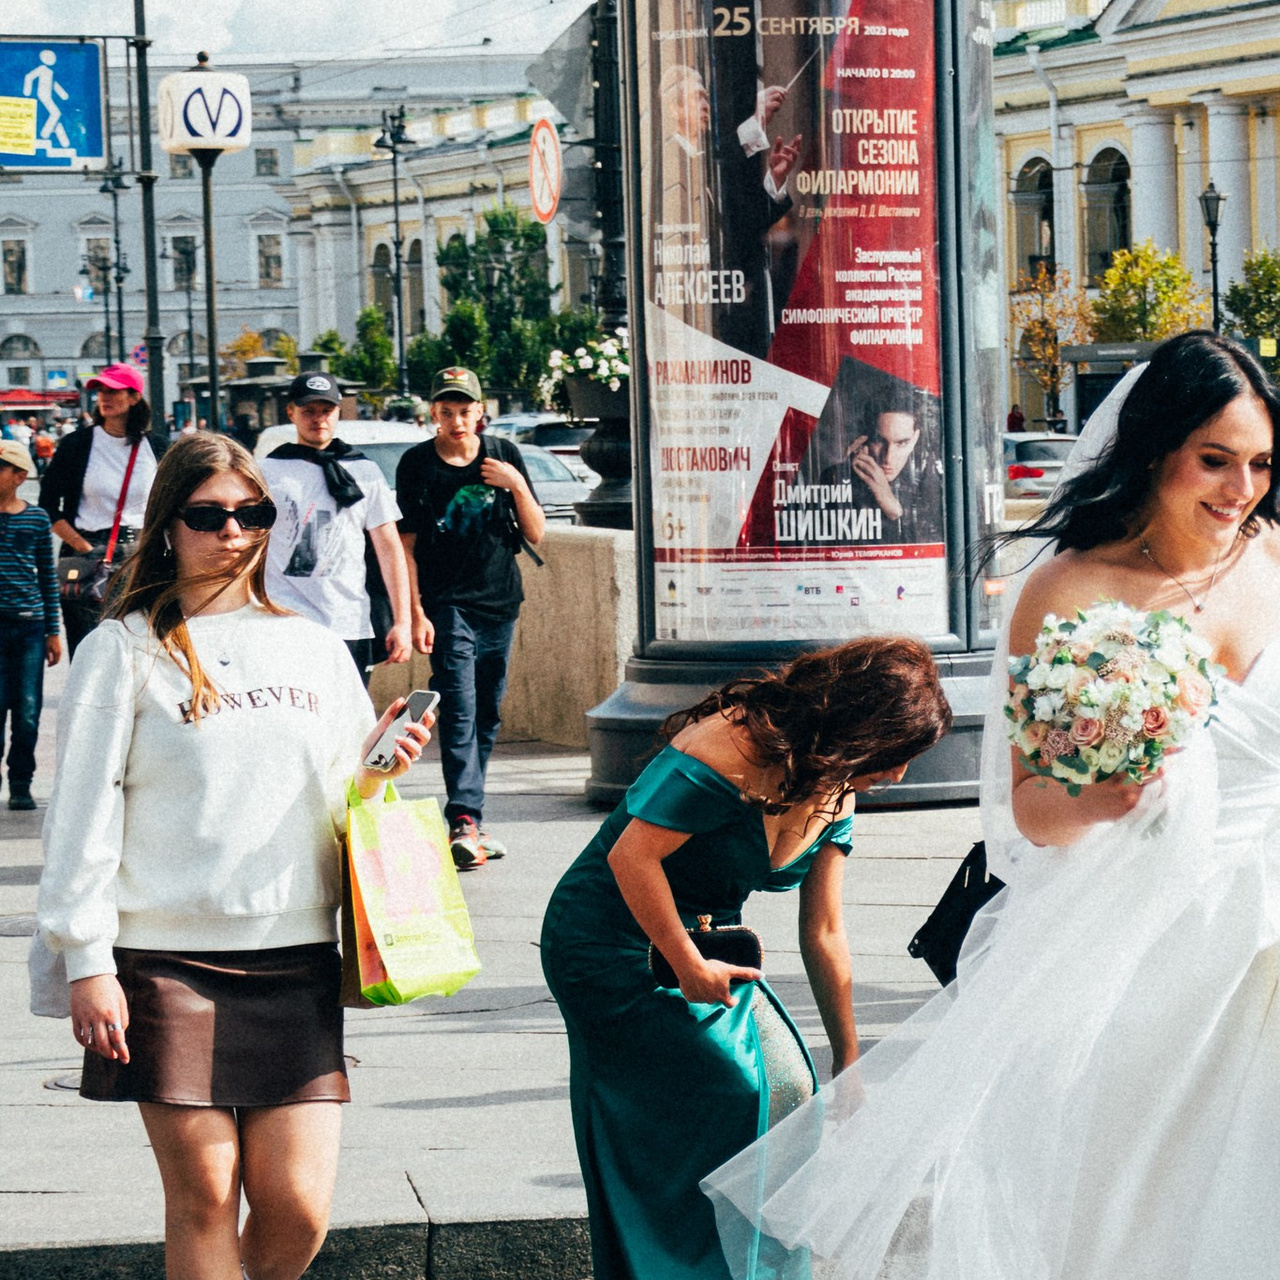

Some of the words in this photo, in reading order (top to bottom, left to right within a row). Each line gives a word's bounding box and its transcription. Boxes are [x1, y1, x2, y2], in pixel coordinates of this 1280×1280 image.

[713, 6, 751, 37] 25
[755, 17, 859, 36] СЕНТЯБРЯ
[864, 25, 887, 36] 2023
[888, 26, 909, 37] года
[837, 68, 880, 78] НАЧАЛО
[882, 68, 889, 78] В
[832, 109, 917, 135] ОТКРЫТИЕ
[858, 139, 919, 165] СЕЗОНА
[796, 170, 919, 195] ФИЛАРМОНИИ
[654, 238, 710, 265] Николай
[654, 270, 746, 304] АЛЕКСЕЕВ
[835, 270, 887, 282] коллектив
[888, 267, 922, 282] России
[845, 286, 922, 303] академический
[781, 305, 879, 324] СИМФОНИЧЕСКИЙ
[881, 307, 923, 323] ОРКЕСТР
[850, 329, 923, 345] ФИЛАРМОНИИ
[656, 359, 752, 385] РАХМАНИНОВ
[662, 446, 751, 471] ШОСТАКОВИЧ
[773, 479, 852, 509] Дмитрий
[661, 513, 685, 540] 6+
[774, 508, 882, 541] ШИШКИН
[804, 586, 821, 595] ВТБ
[177, 686, 321, 725] HOWEVER
